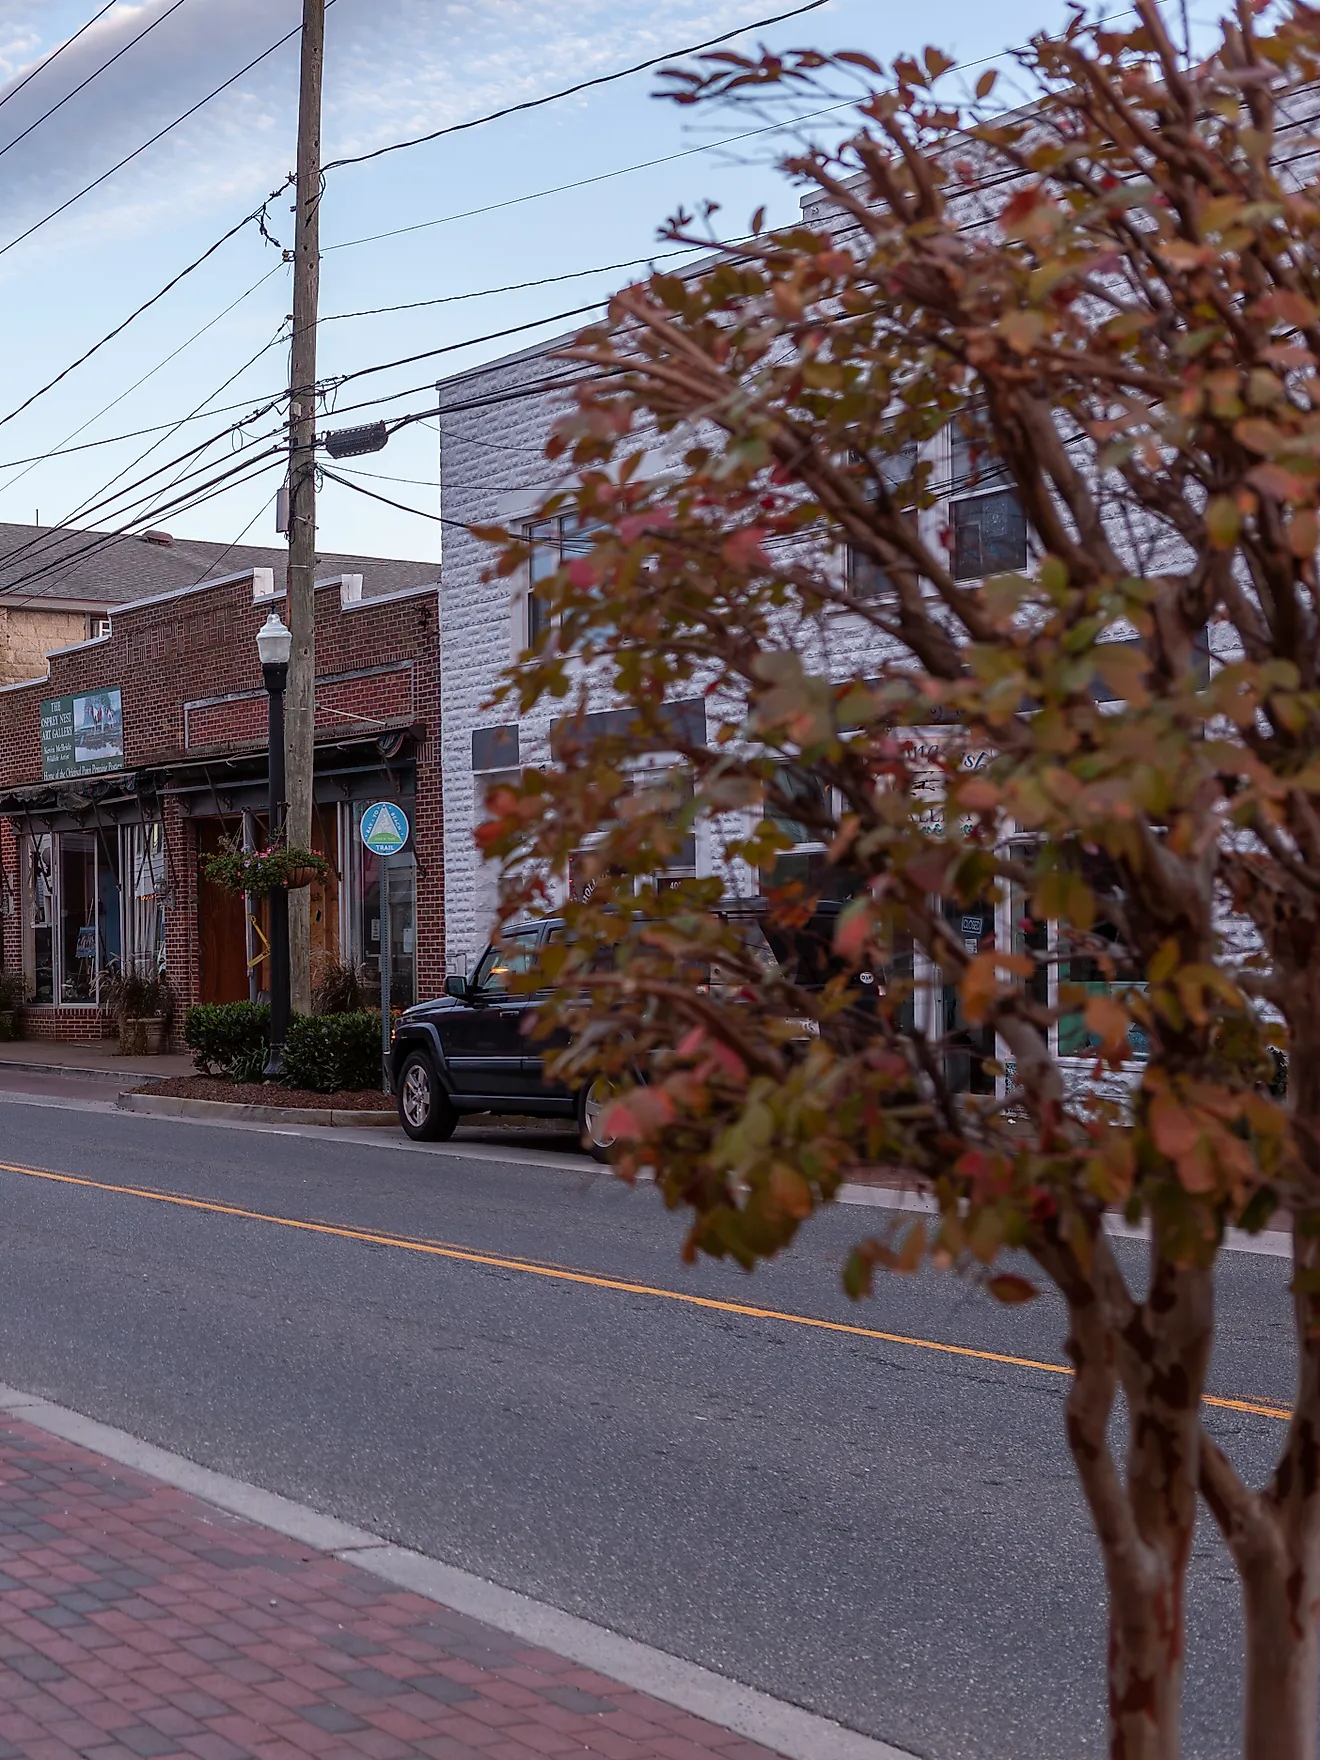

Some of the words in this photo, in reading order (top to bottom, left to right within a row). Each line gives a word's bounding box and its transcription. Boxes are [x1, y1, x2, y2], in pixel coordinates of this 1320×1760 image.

[51, 701, 60, 712] THE
[41, 715, 59, 728] OSPREY
[60, 713, 71, 724] NEST
[42, 730, 51, 740] ART
[52, 727, 72, 738] GALLERY
[391, 812, 401, 830] BEACH
[963, 919, 981, 931] CLOSED
